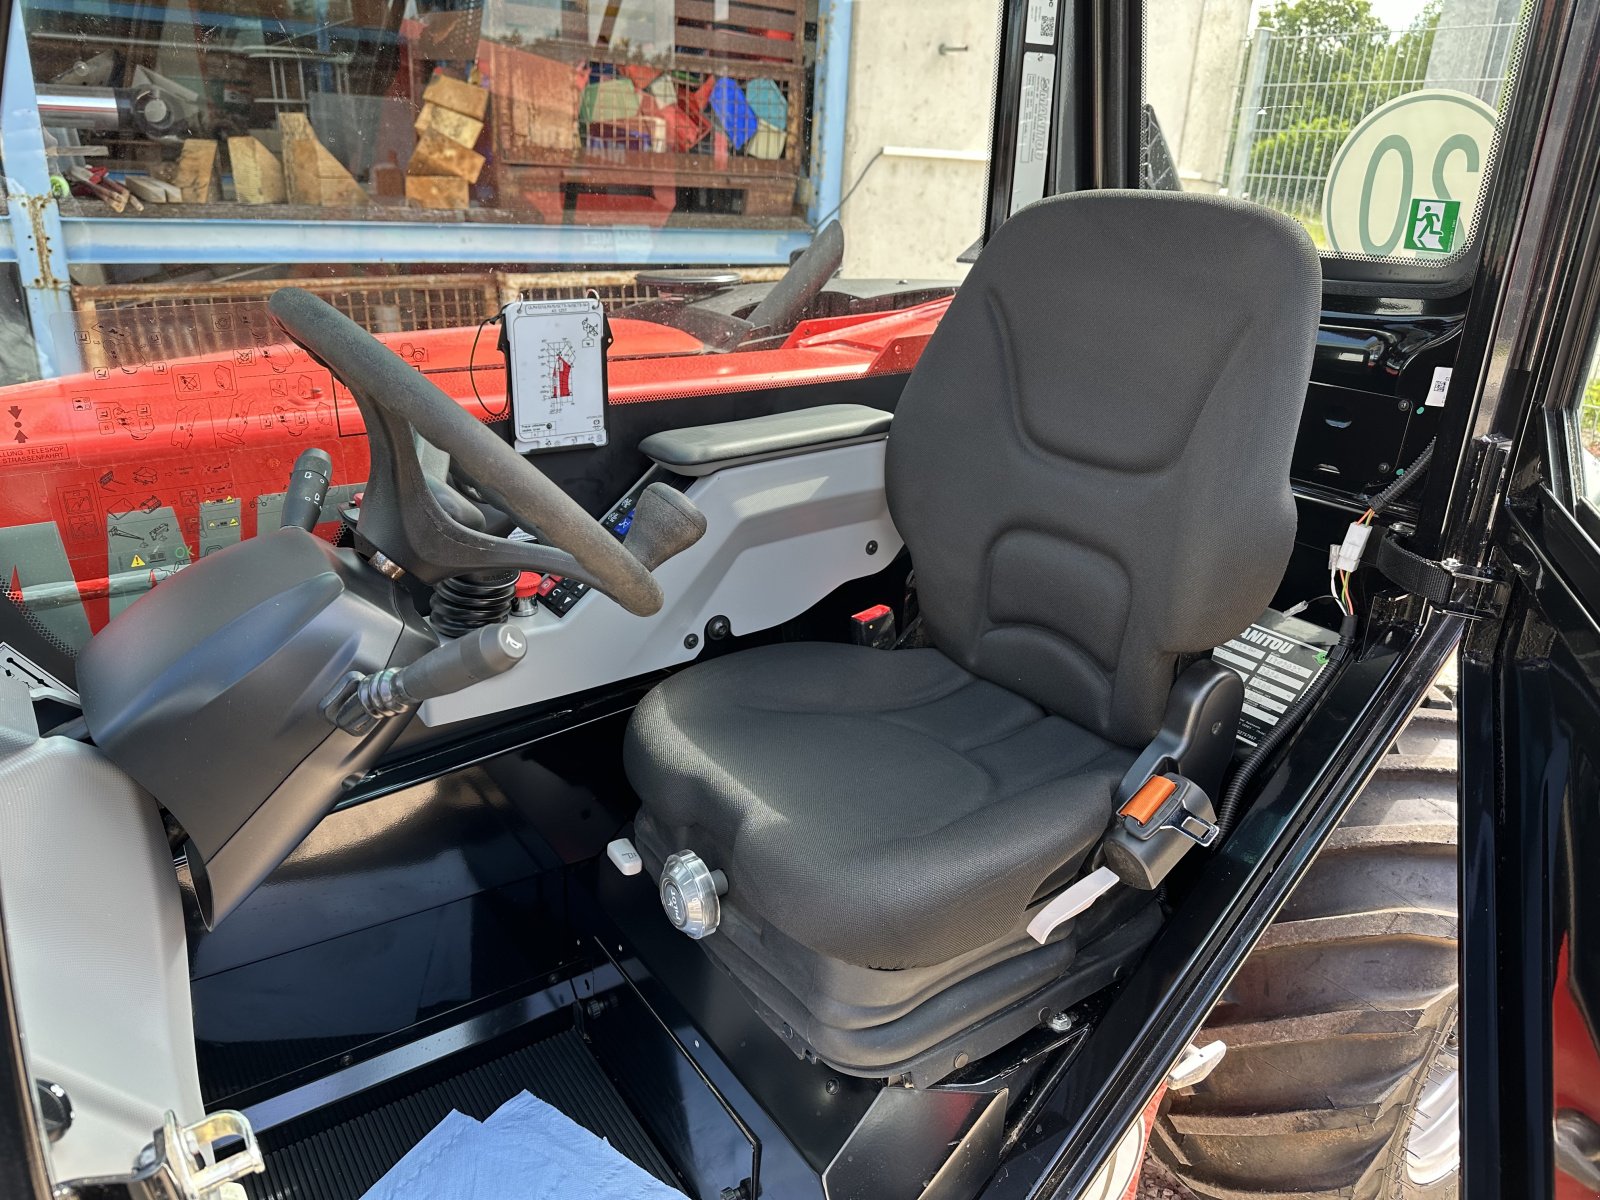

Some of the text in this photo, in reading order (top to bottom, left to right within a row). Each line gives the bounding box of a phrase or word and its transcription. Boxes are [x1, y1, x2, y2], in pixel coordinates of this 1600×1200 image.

[1035, 91, 1048, 161] MANITOU
[27, 445, 65, 456] TELESKOP
[2, 452, 65, 464] STRASSENFAHRT
[175, 545, 195, 558] OK
[1240, 627, 1295, 654] ANITOU
